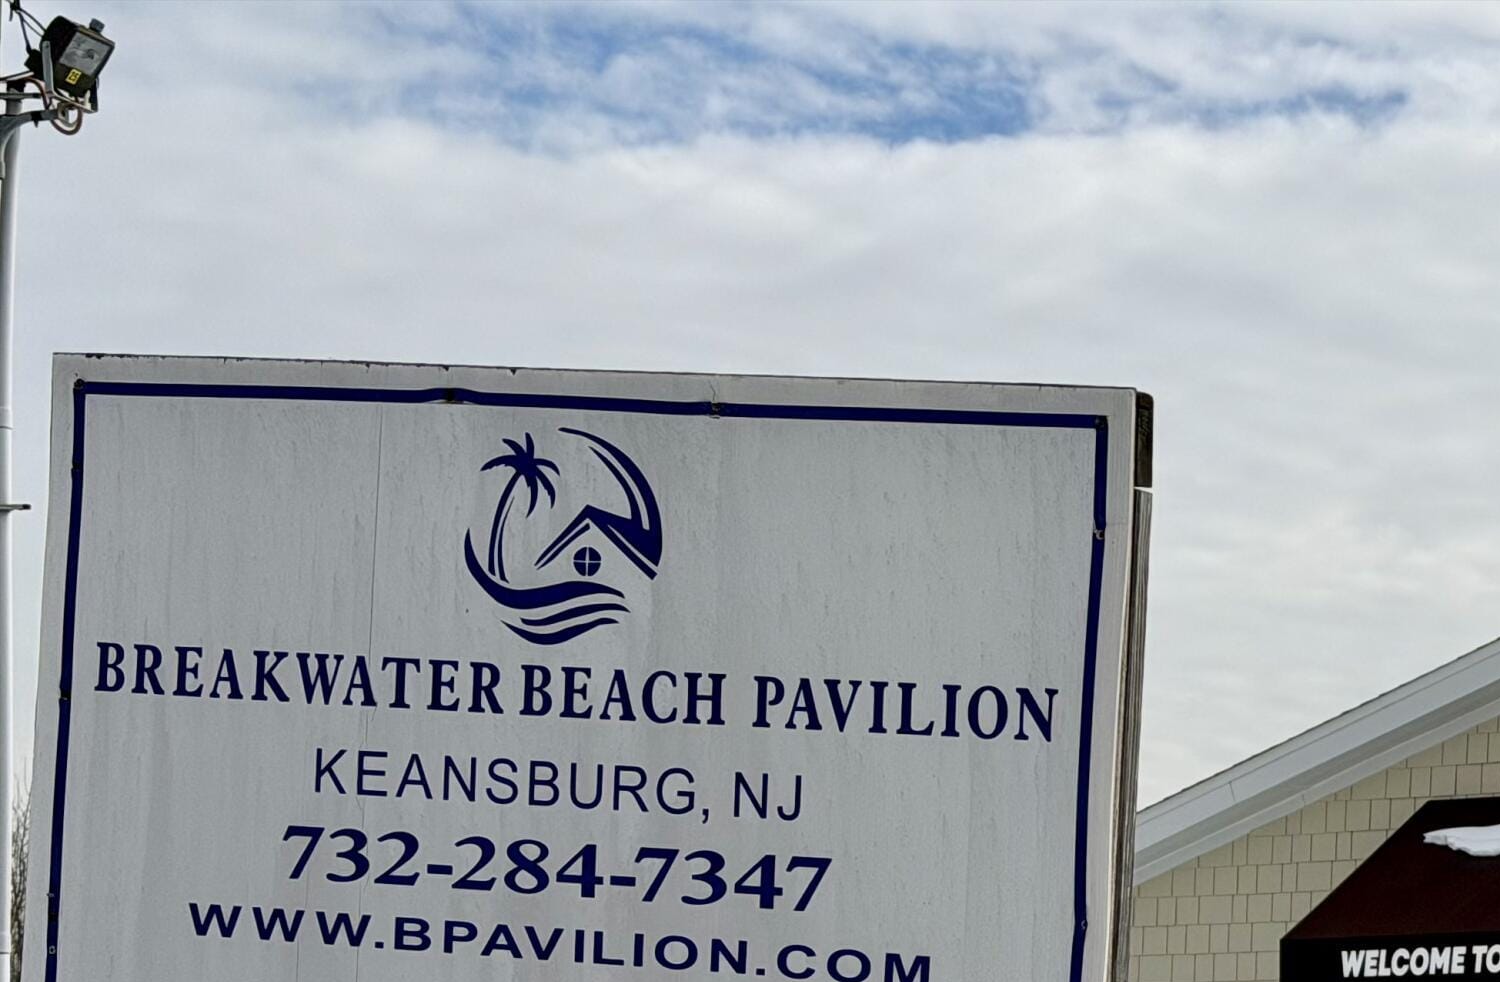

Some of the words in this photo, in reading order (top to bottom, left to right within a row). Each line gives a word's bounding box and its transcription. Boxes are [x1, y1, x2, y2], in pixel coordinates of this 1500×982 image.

[94, 641, 504, 715] BREAKWATER
[519, 664, 727, 726] BEACH
[751, 675, 1059, 743] PAVILION
[314, 747, 710, 825] KEANSBURG,
[733, 771, 802, 822] NJ
[281, 825, 833, 912] 732-284-7347
[1341, 945, 1467, 978] WELCOME
